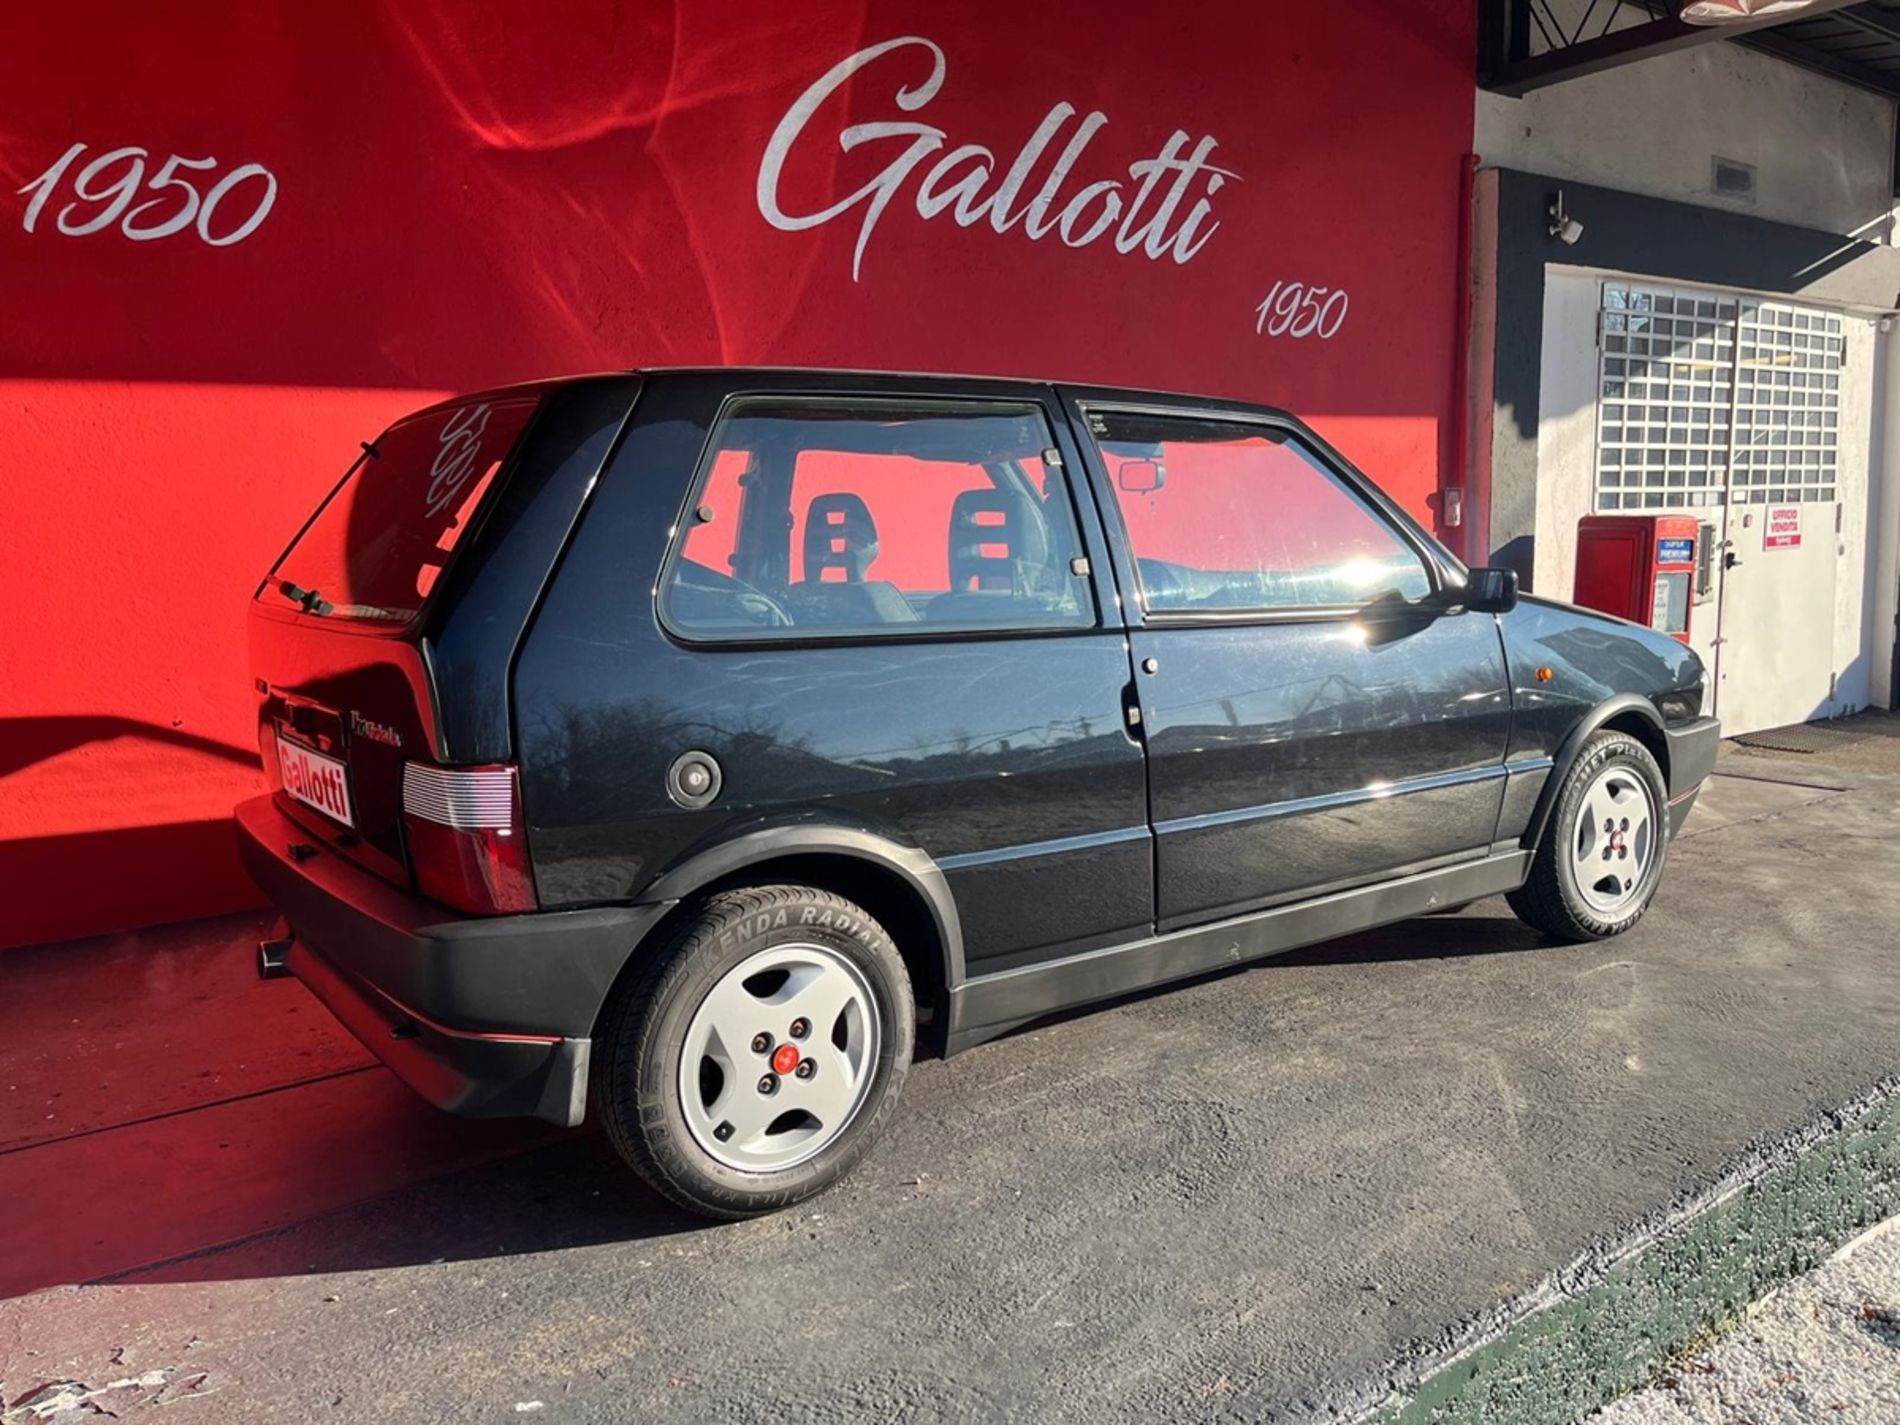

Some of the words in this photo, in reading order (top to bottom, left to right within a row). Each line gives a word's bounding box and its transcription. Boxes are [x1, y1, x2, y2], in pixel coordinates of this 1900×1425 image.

[18, 144, 278, 246] 1950
[757, 37, 1242, 282] Gallotti
[1256, 281, 1349, 339] 1950
[280, 745, 347, 818] Gallotti
[702, 908, 788, 965] KENDA
[801, 906, 883, 954] RADIAL
